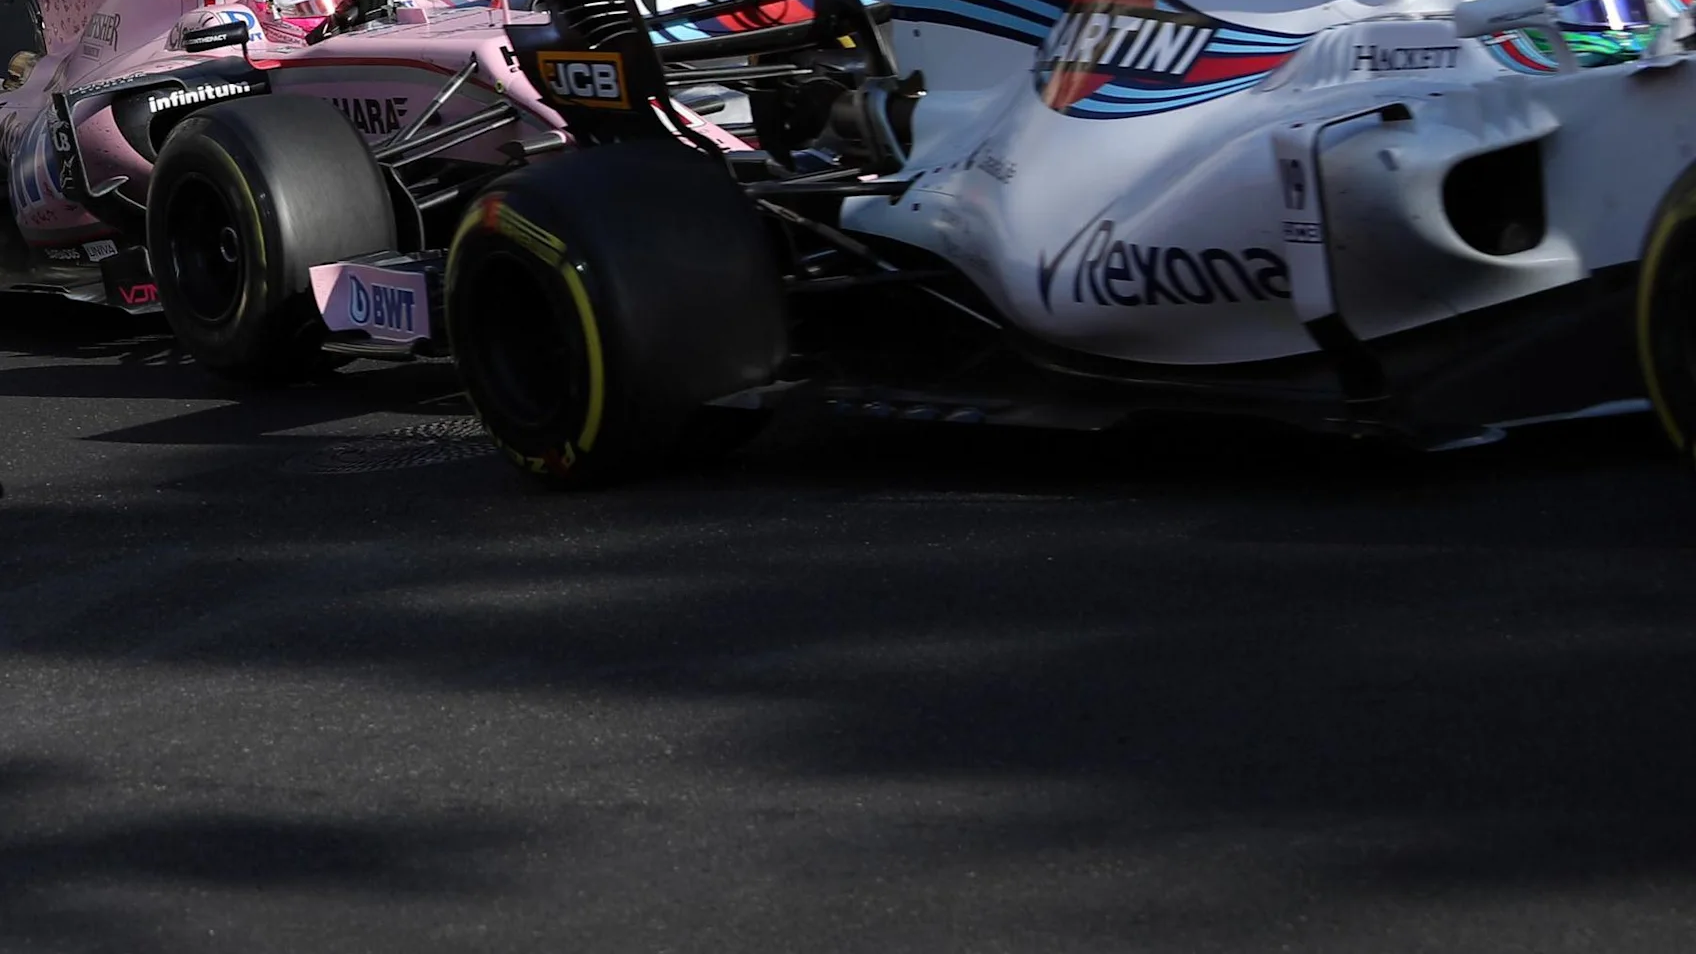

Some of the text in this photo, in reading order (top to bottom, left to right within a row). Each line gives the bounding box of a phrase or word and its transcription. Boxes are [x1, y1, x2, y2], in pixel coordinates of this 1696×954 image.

[148, 82, 251, 113] infinitum
[548, 62, 620, 99] JCB
[1072, 219, 1293, 307] Rexona
[371, 284, 415, 333] BWT
